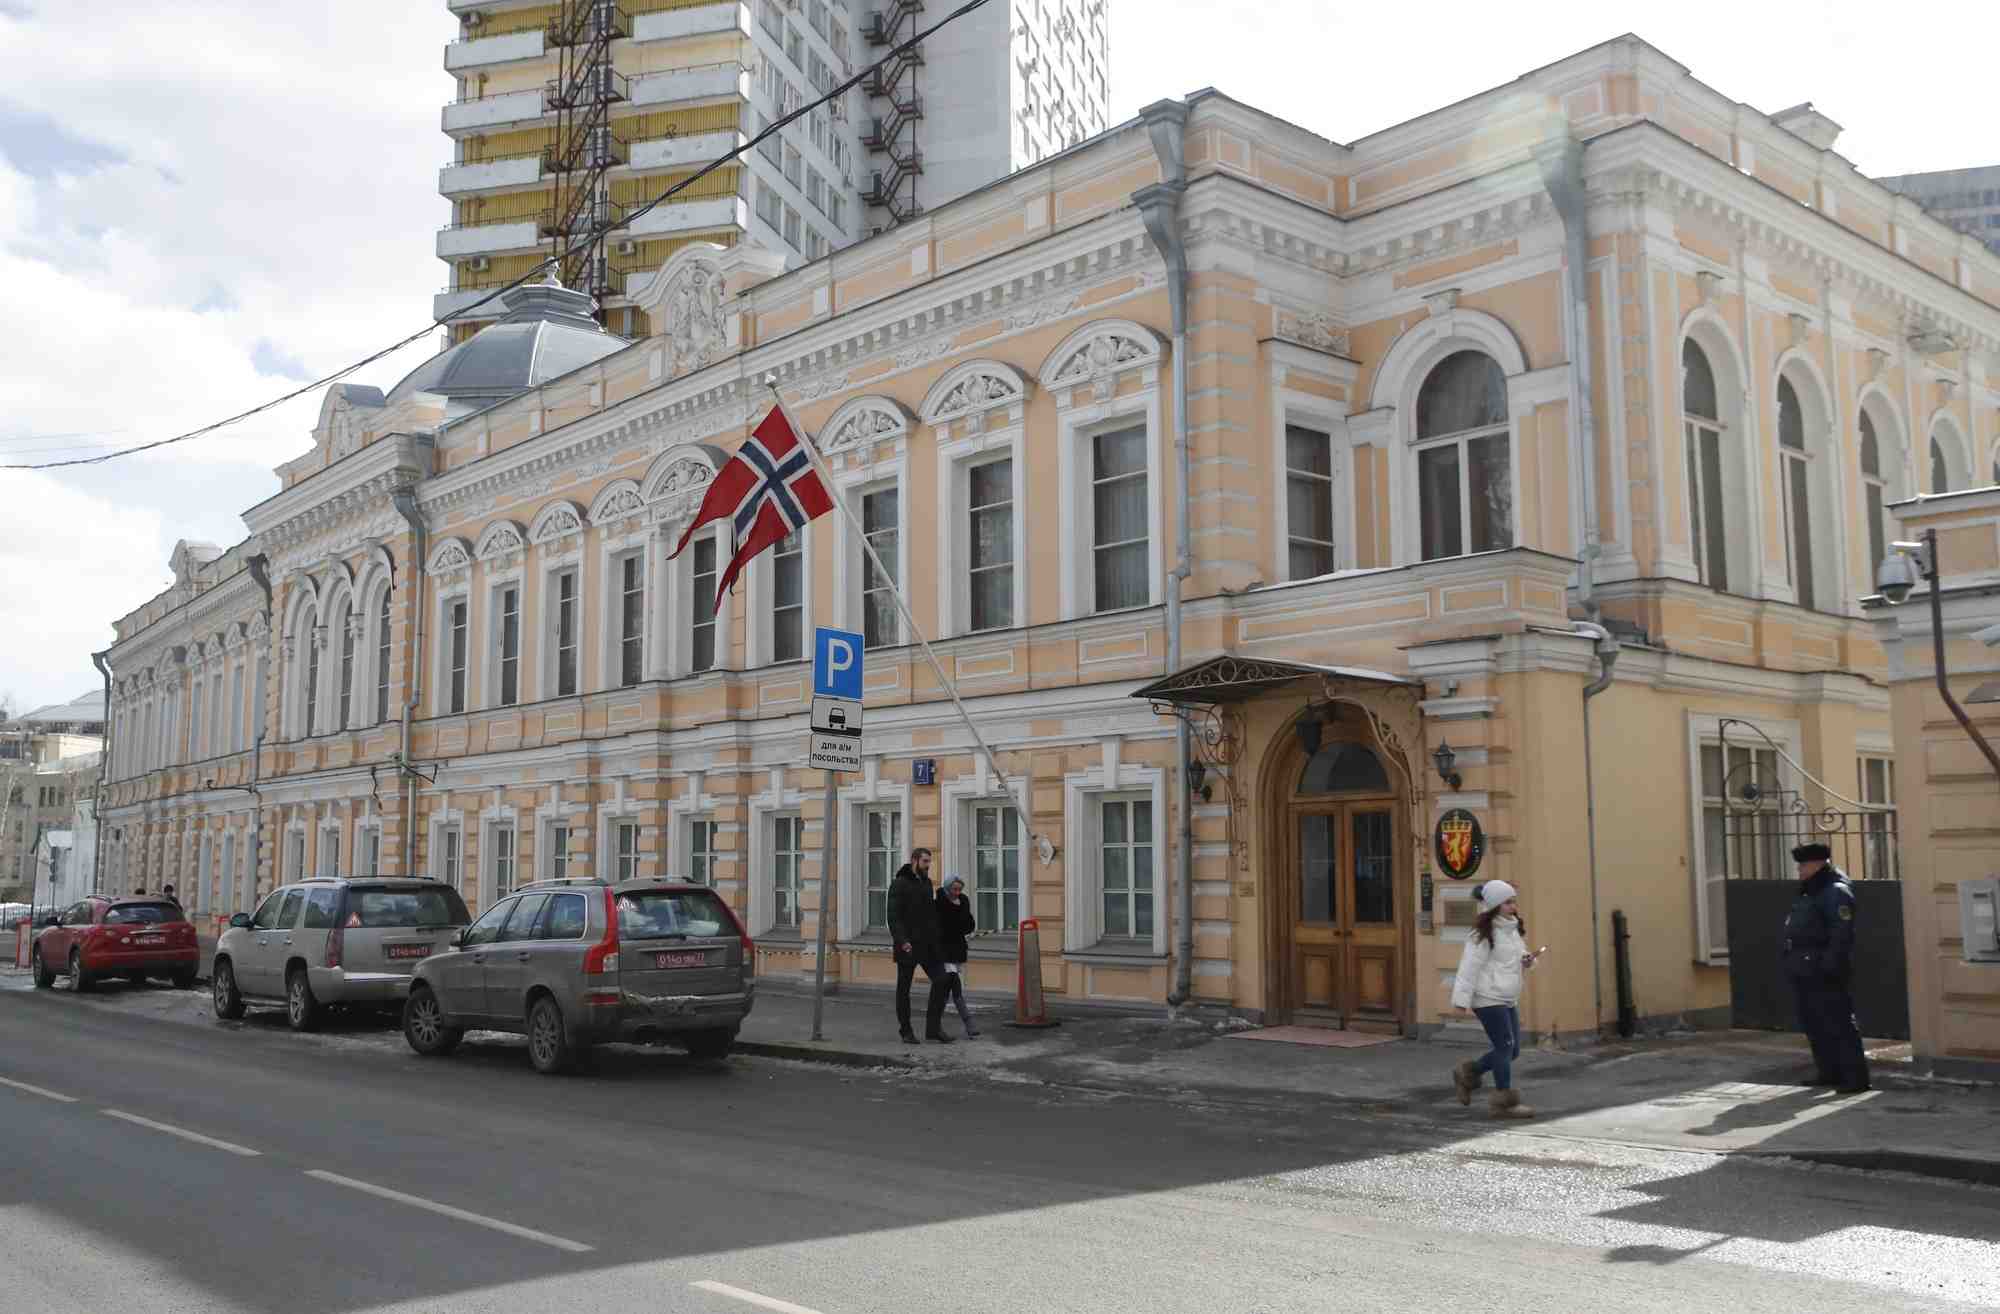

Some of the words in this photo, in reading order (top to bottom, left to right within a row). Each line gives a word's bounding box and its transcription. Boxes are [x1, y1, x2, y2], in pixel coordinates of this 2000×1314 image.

[827, 638, 853, 688] P
[821, 742, 837, 750] для
[812, 753, 859, 765] посольства
[917, 764, 925, 777] 7
